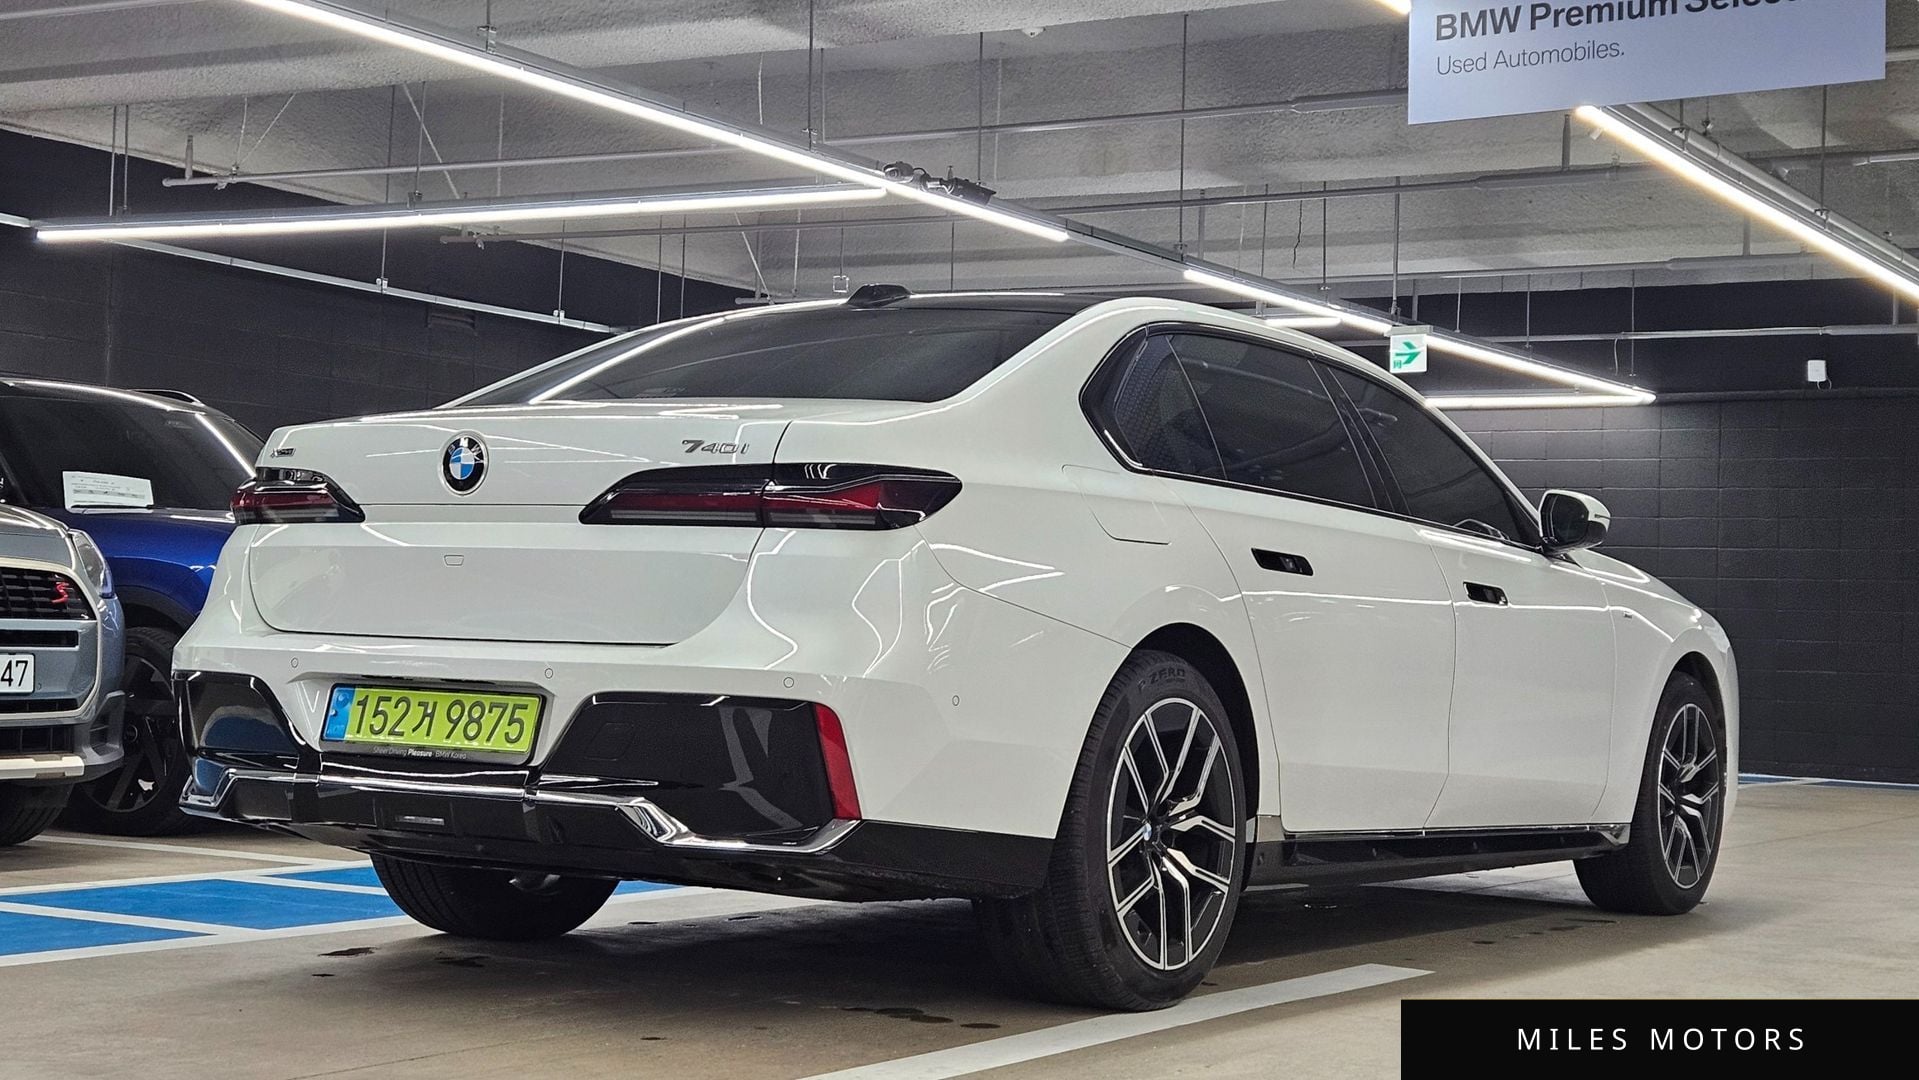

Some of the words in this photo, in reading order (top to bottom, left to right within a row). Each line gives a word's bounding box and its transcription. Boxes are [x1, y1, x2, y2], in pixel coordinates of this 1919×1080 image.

[1436, 5, 1521, 41] BMW
[1530, 0, 1678, 30] Premium
[1437, 51, 1487, 75] Used
[1493, 40, 1625, 69] Automobiles.
[0, 660, 28, 687] 47
[356, 694, 438, 736] 152거
[445, 699, 528, 744] 9875
[407, 748, 433, 757] Pleasure
